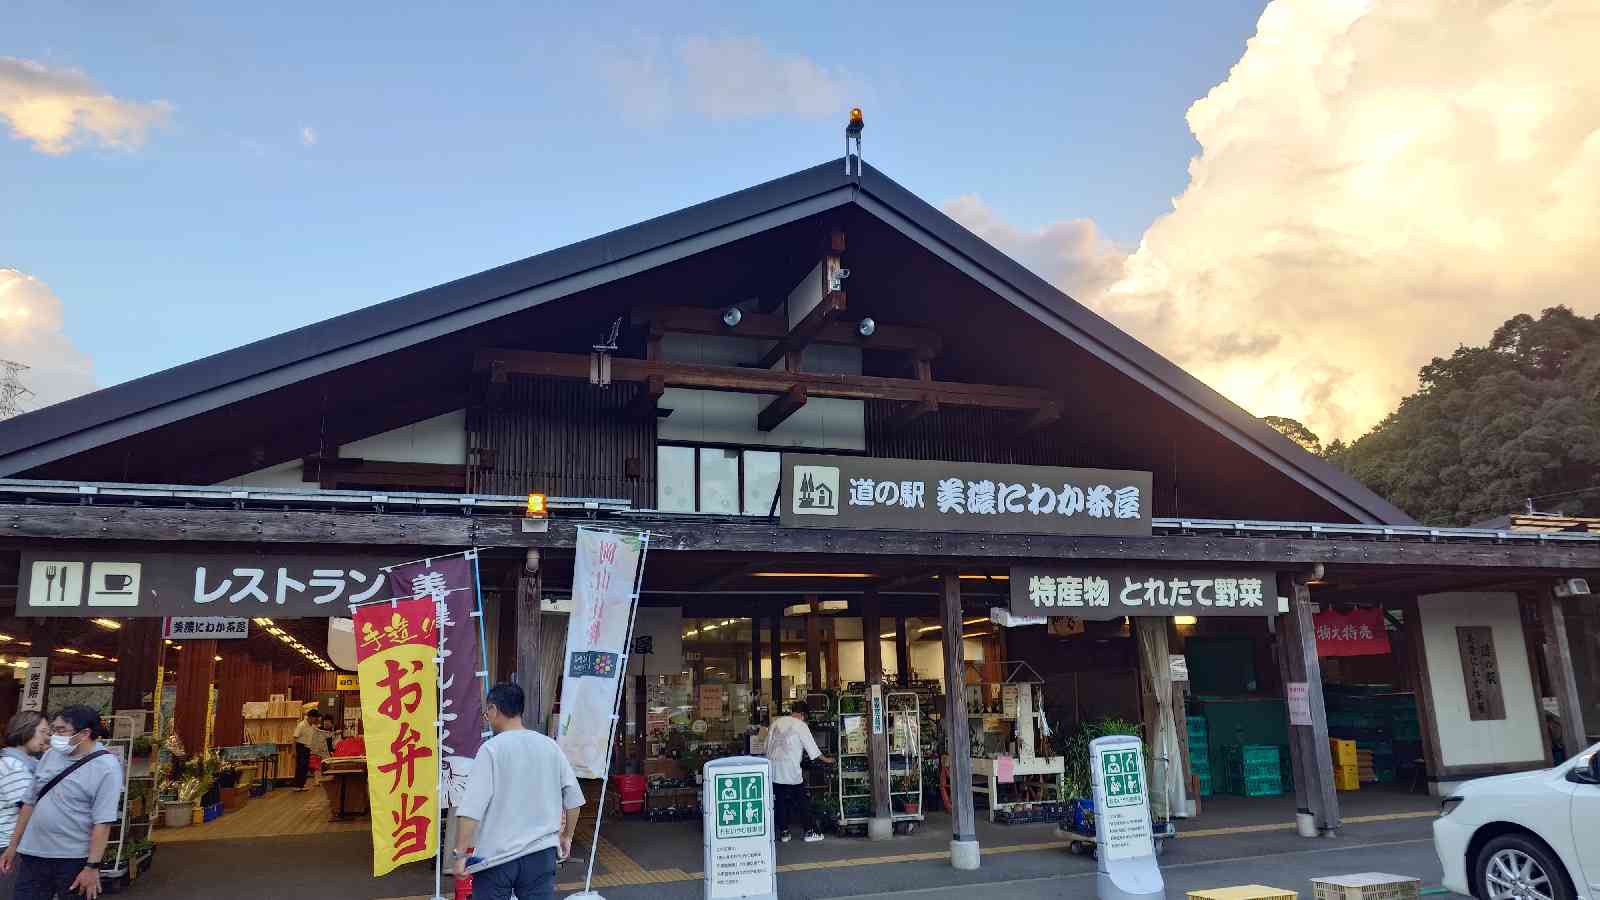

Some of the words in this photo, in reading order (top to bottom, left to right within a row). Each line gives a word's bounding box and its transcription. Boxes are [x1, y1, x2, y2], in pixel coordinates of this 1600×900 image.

[850, 478, 925, 509] 道の駅
[936, 476, 1141, 520] 美濃にわか茶屋
[194, 567, 386, 605] レストラン
[1028, 576, 1110, 607] 特産物
[1120, 577, 1263, 608] とれたて野菜
[360, 612, 435, 651] 手造り
[377, 659, 433, 862] お弁当
